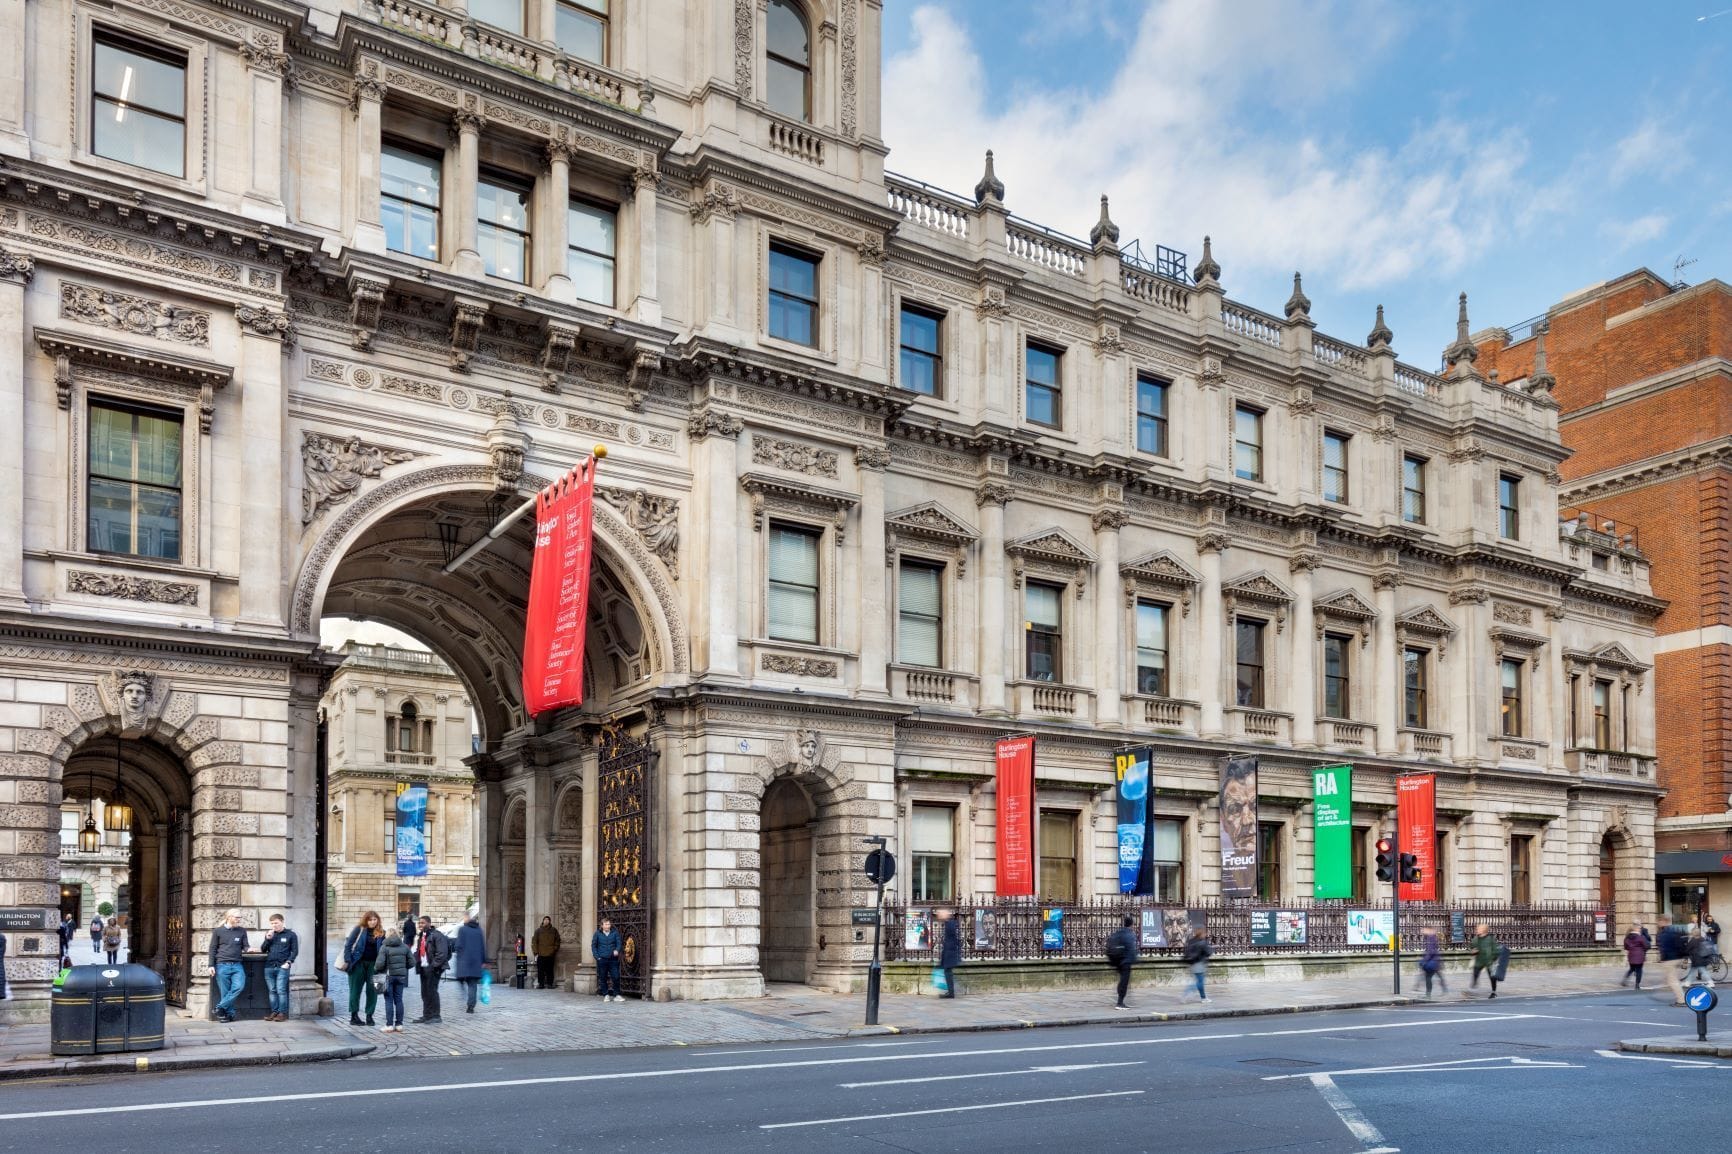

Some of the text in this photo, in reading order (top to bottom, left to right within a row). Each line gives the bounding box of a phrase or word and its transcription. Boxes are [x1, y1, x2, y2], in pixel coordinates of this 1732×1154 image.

[998, 743, 1029, 752] Burlington
[998, 751, 1017, 759] House
[1316, 773, 1338, 795] RA
[1399, 778, 1430, 786] Burlington
[1222, 853, 1255, 866] Freud
[1142, 911, 1154, 927] RA
[1142, 935, 1161, 943] Freud
